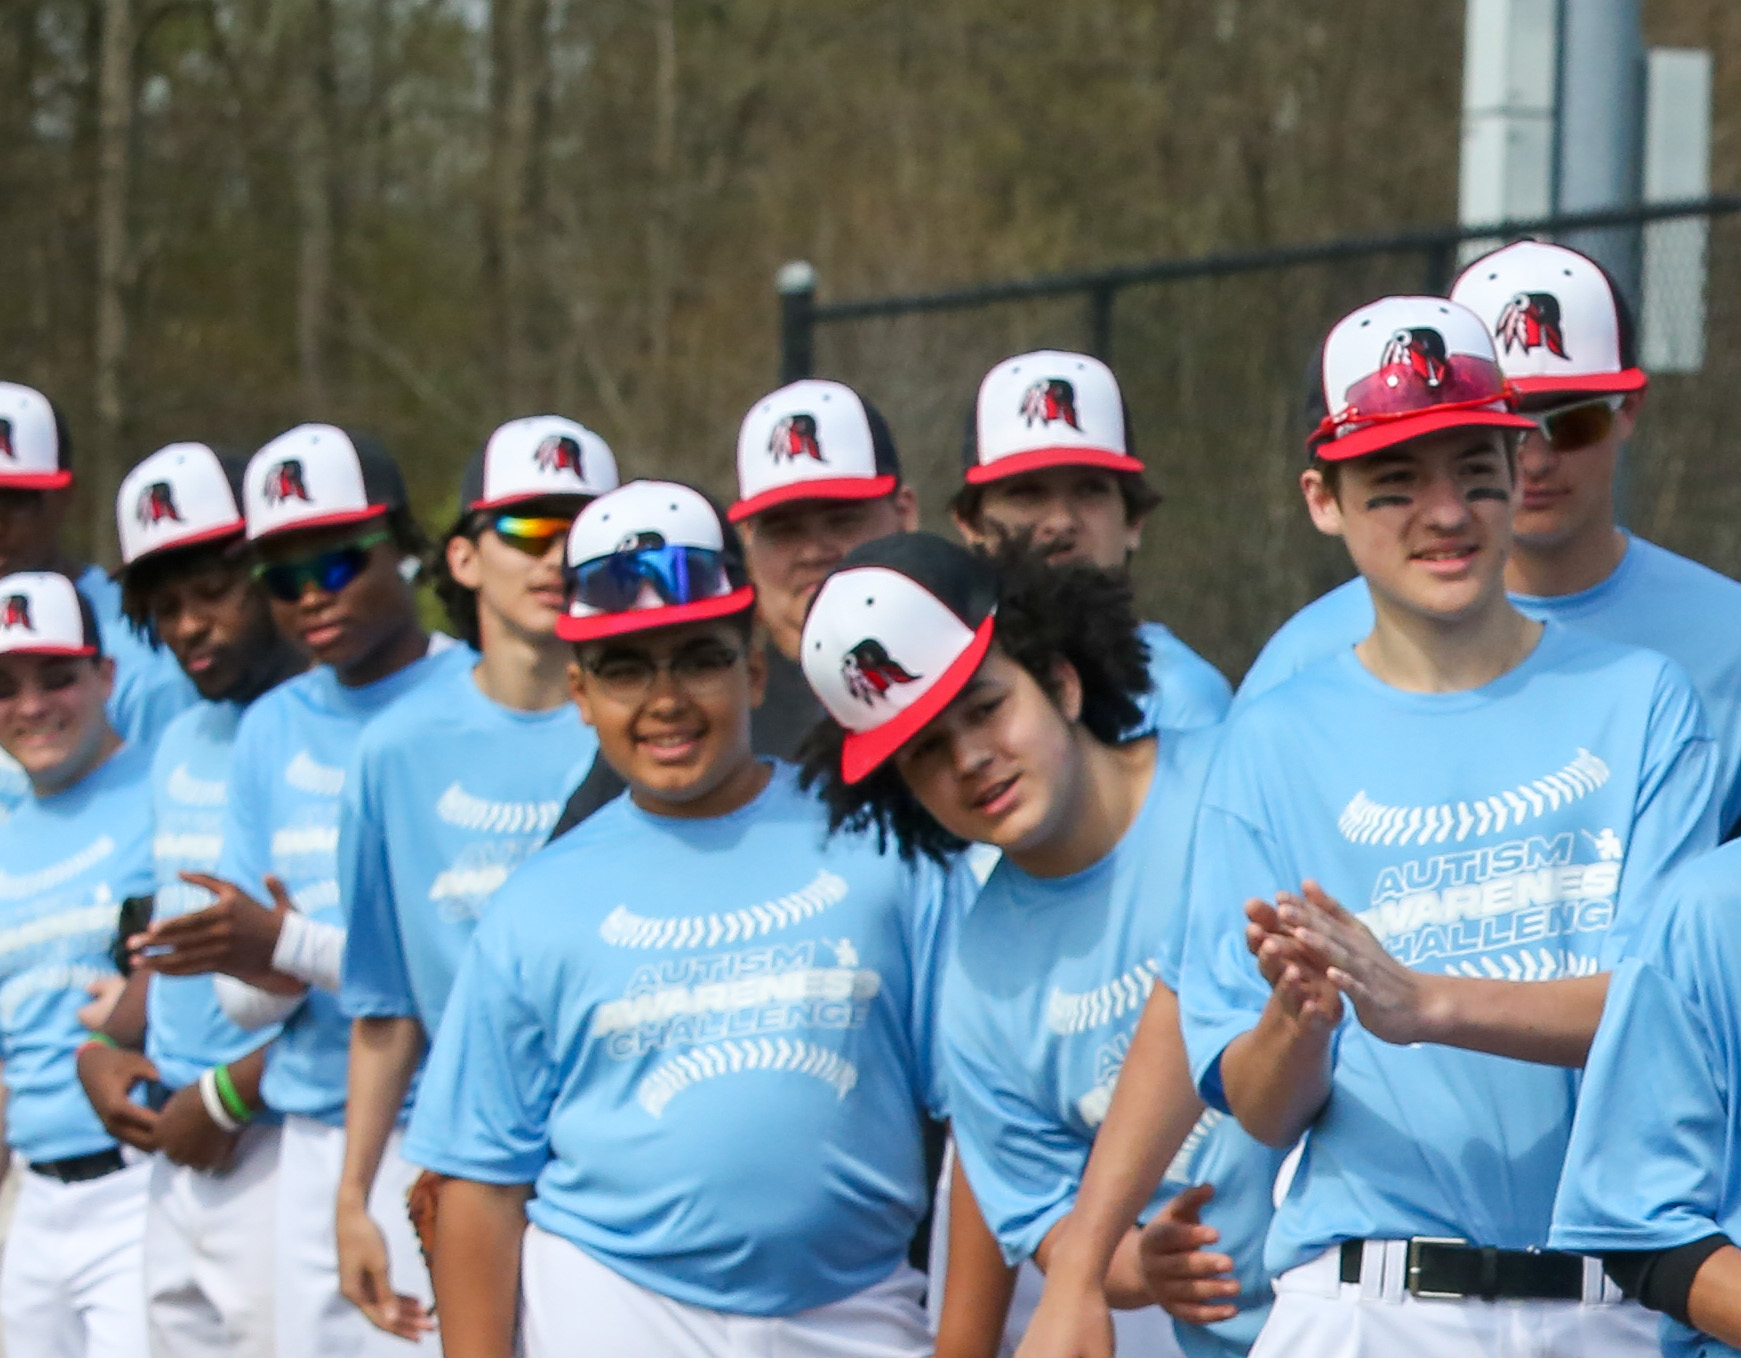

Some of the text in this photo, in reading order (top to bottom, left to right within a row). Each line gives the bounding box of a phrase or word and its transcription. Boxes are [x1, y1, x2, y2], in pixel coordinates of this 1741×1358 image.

[1356, 862, 1621, 942] WARENES
[1371, 833, 1574, 905] AUTISM
[1384, 899, 1613, 966] HALLENG
[593, 968, 881, 1038] AWARENESS
[625, 940, 816, 1000] AUTISM
[606, 1000, 869, 1060] CHALLENGE
